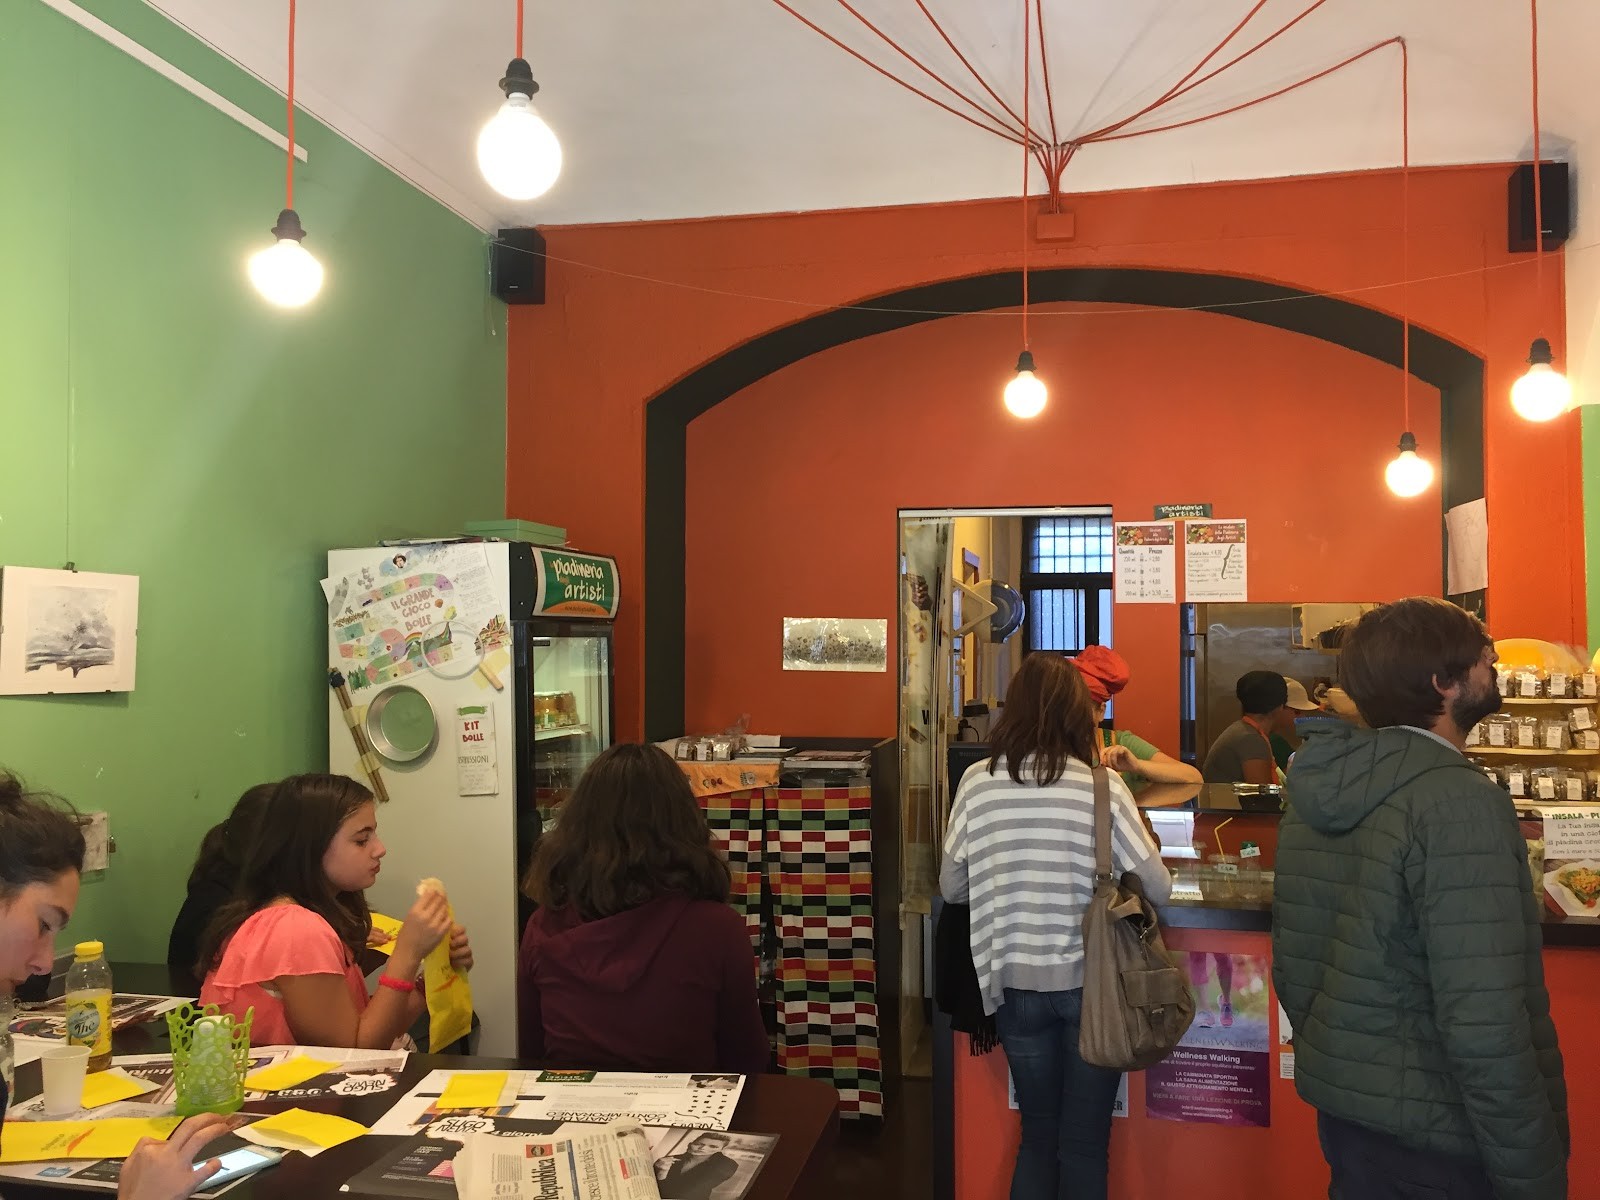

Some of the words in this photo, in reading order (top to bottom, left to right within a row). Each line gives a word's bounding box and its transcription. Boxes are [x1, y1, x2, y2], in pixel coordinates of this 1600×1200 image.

[564, 580, 605, 601] artisti
[391, 601, 401, 611] IL
[400, 588, 434, 607] GRANDE
[402, 602, 431, 618] GIOCO
[405, 614, 432, 631] BOLLE
[464, 720, 479, 731] KIT
[462, 733, 484, 743] BOLLE
[1172, 1051, 1208, 1061] Wellness
[1209, 1053, 1241, 1065] Walking
[446, 1119, 487, 1129] SUGO
[531, 1158, 563, 1200] Repubblica
